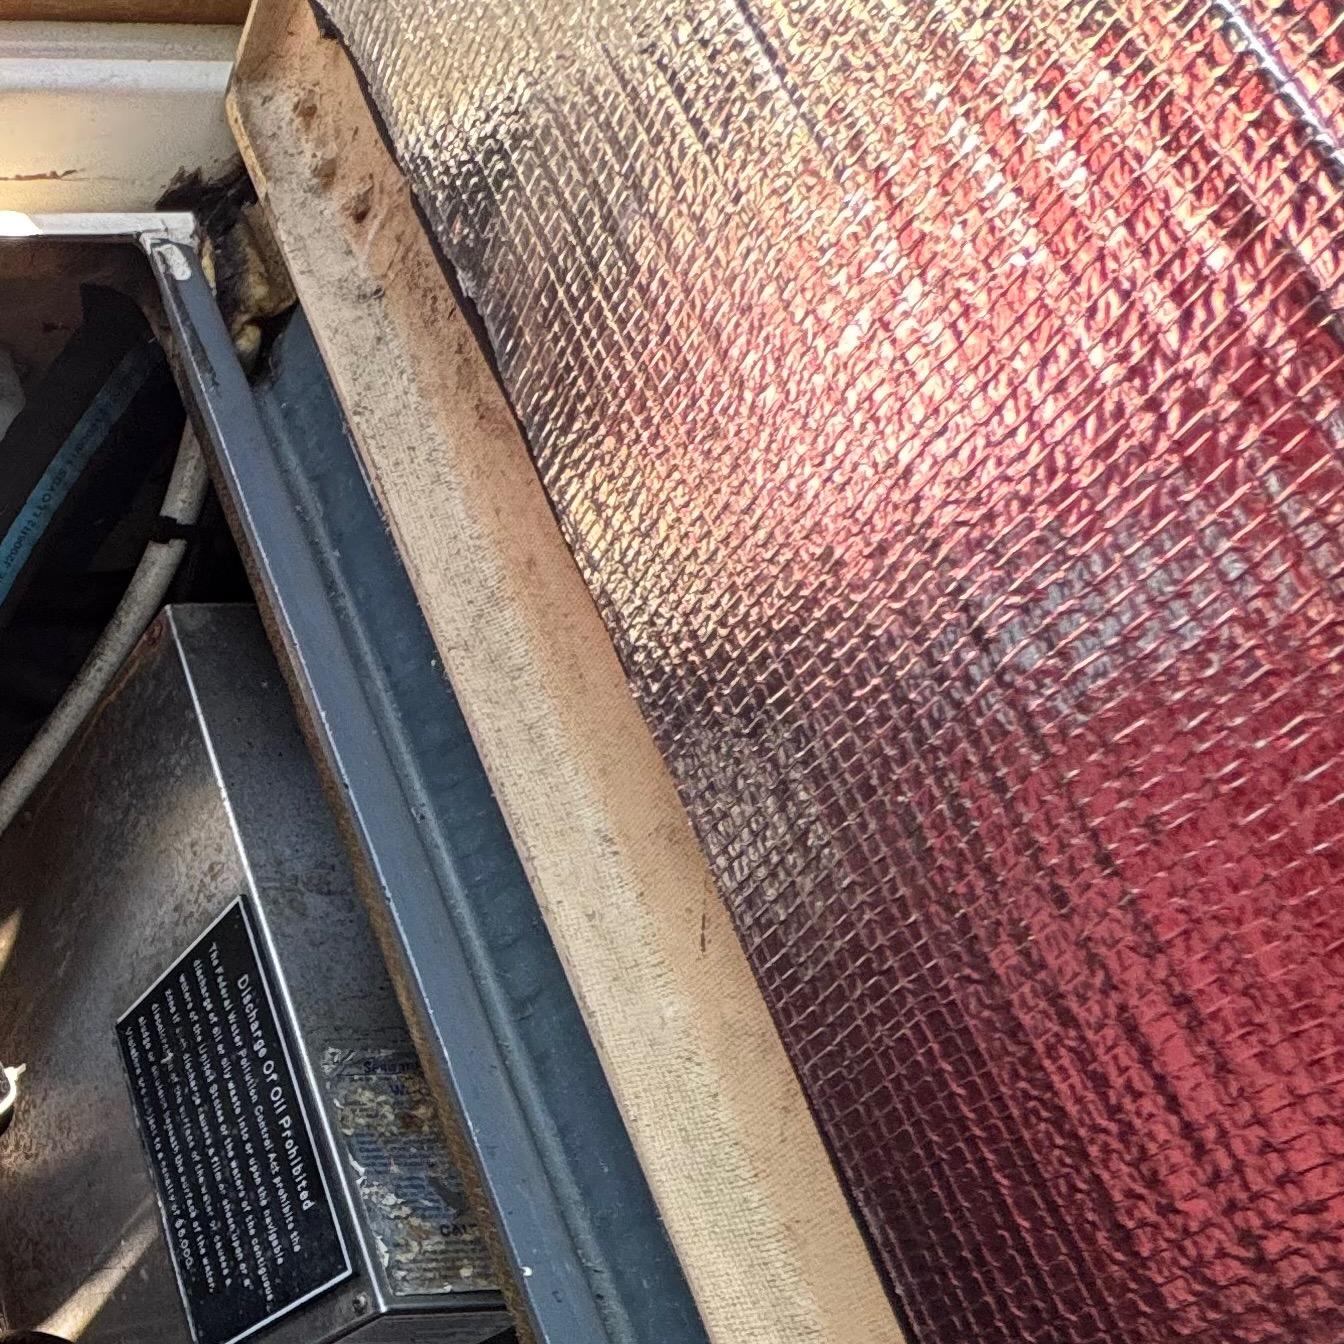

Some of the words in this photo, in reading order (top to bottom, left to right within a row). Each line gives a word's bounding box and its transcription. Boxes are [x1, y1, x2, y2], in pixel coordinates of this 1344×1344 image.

[206, 940, 221, 968] The
[191, 955, 214, 1014] discharge
[213, 963, 234, 1013] Federal
[191, 1021, 204, 1044] the
[226, 1008, 244, 1050] Water
[234, 971, 270, 1063] Discharge
[197, 1041, 215, 1085] United
[236, 1046, 260, 1105] Pollution
[261, 1056, 278, 1087] Of
[208, 1082, 225, 1124] States
[225, 1078, 242, 1117] waste
[268, 1082, 287, 1116] Oil
[177, 1102, 196, 1150] surface
[236, 1113, 251, 1143] into
[252, 1102, 274, 1153] Control
[190, 1147, 201, 1164] of
[222, 1135, 235, 1160] the
[243, 1140, 253, 1157] or
[266, 1149, 281, 1176] Act
[277, 1112, 316, 1212] Prohibited
[194, 1161, 206, 1185] the
[210, 1154, 224, 1183] film
[228, 1157, 246, 1200] waters
[246, 1155, 262, 1188] upon
[170, 1201, 181, 1217] of
[174, 1152, 185, 1175] the
[195, 1233, 207, 1256] the
[199, 1183, 214, 1219] water
[239, 1197, 251, 1215] of
[255, 1184, 269, 1208] the
[243, 1213, 256, 1237] the
[260, 1206, 285, 1268] navigable
[288, 1229, 303, 1254] the
[212, 1232, 230, 1277] causes
[248, 1235, 274, 1304] contiguous
